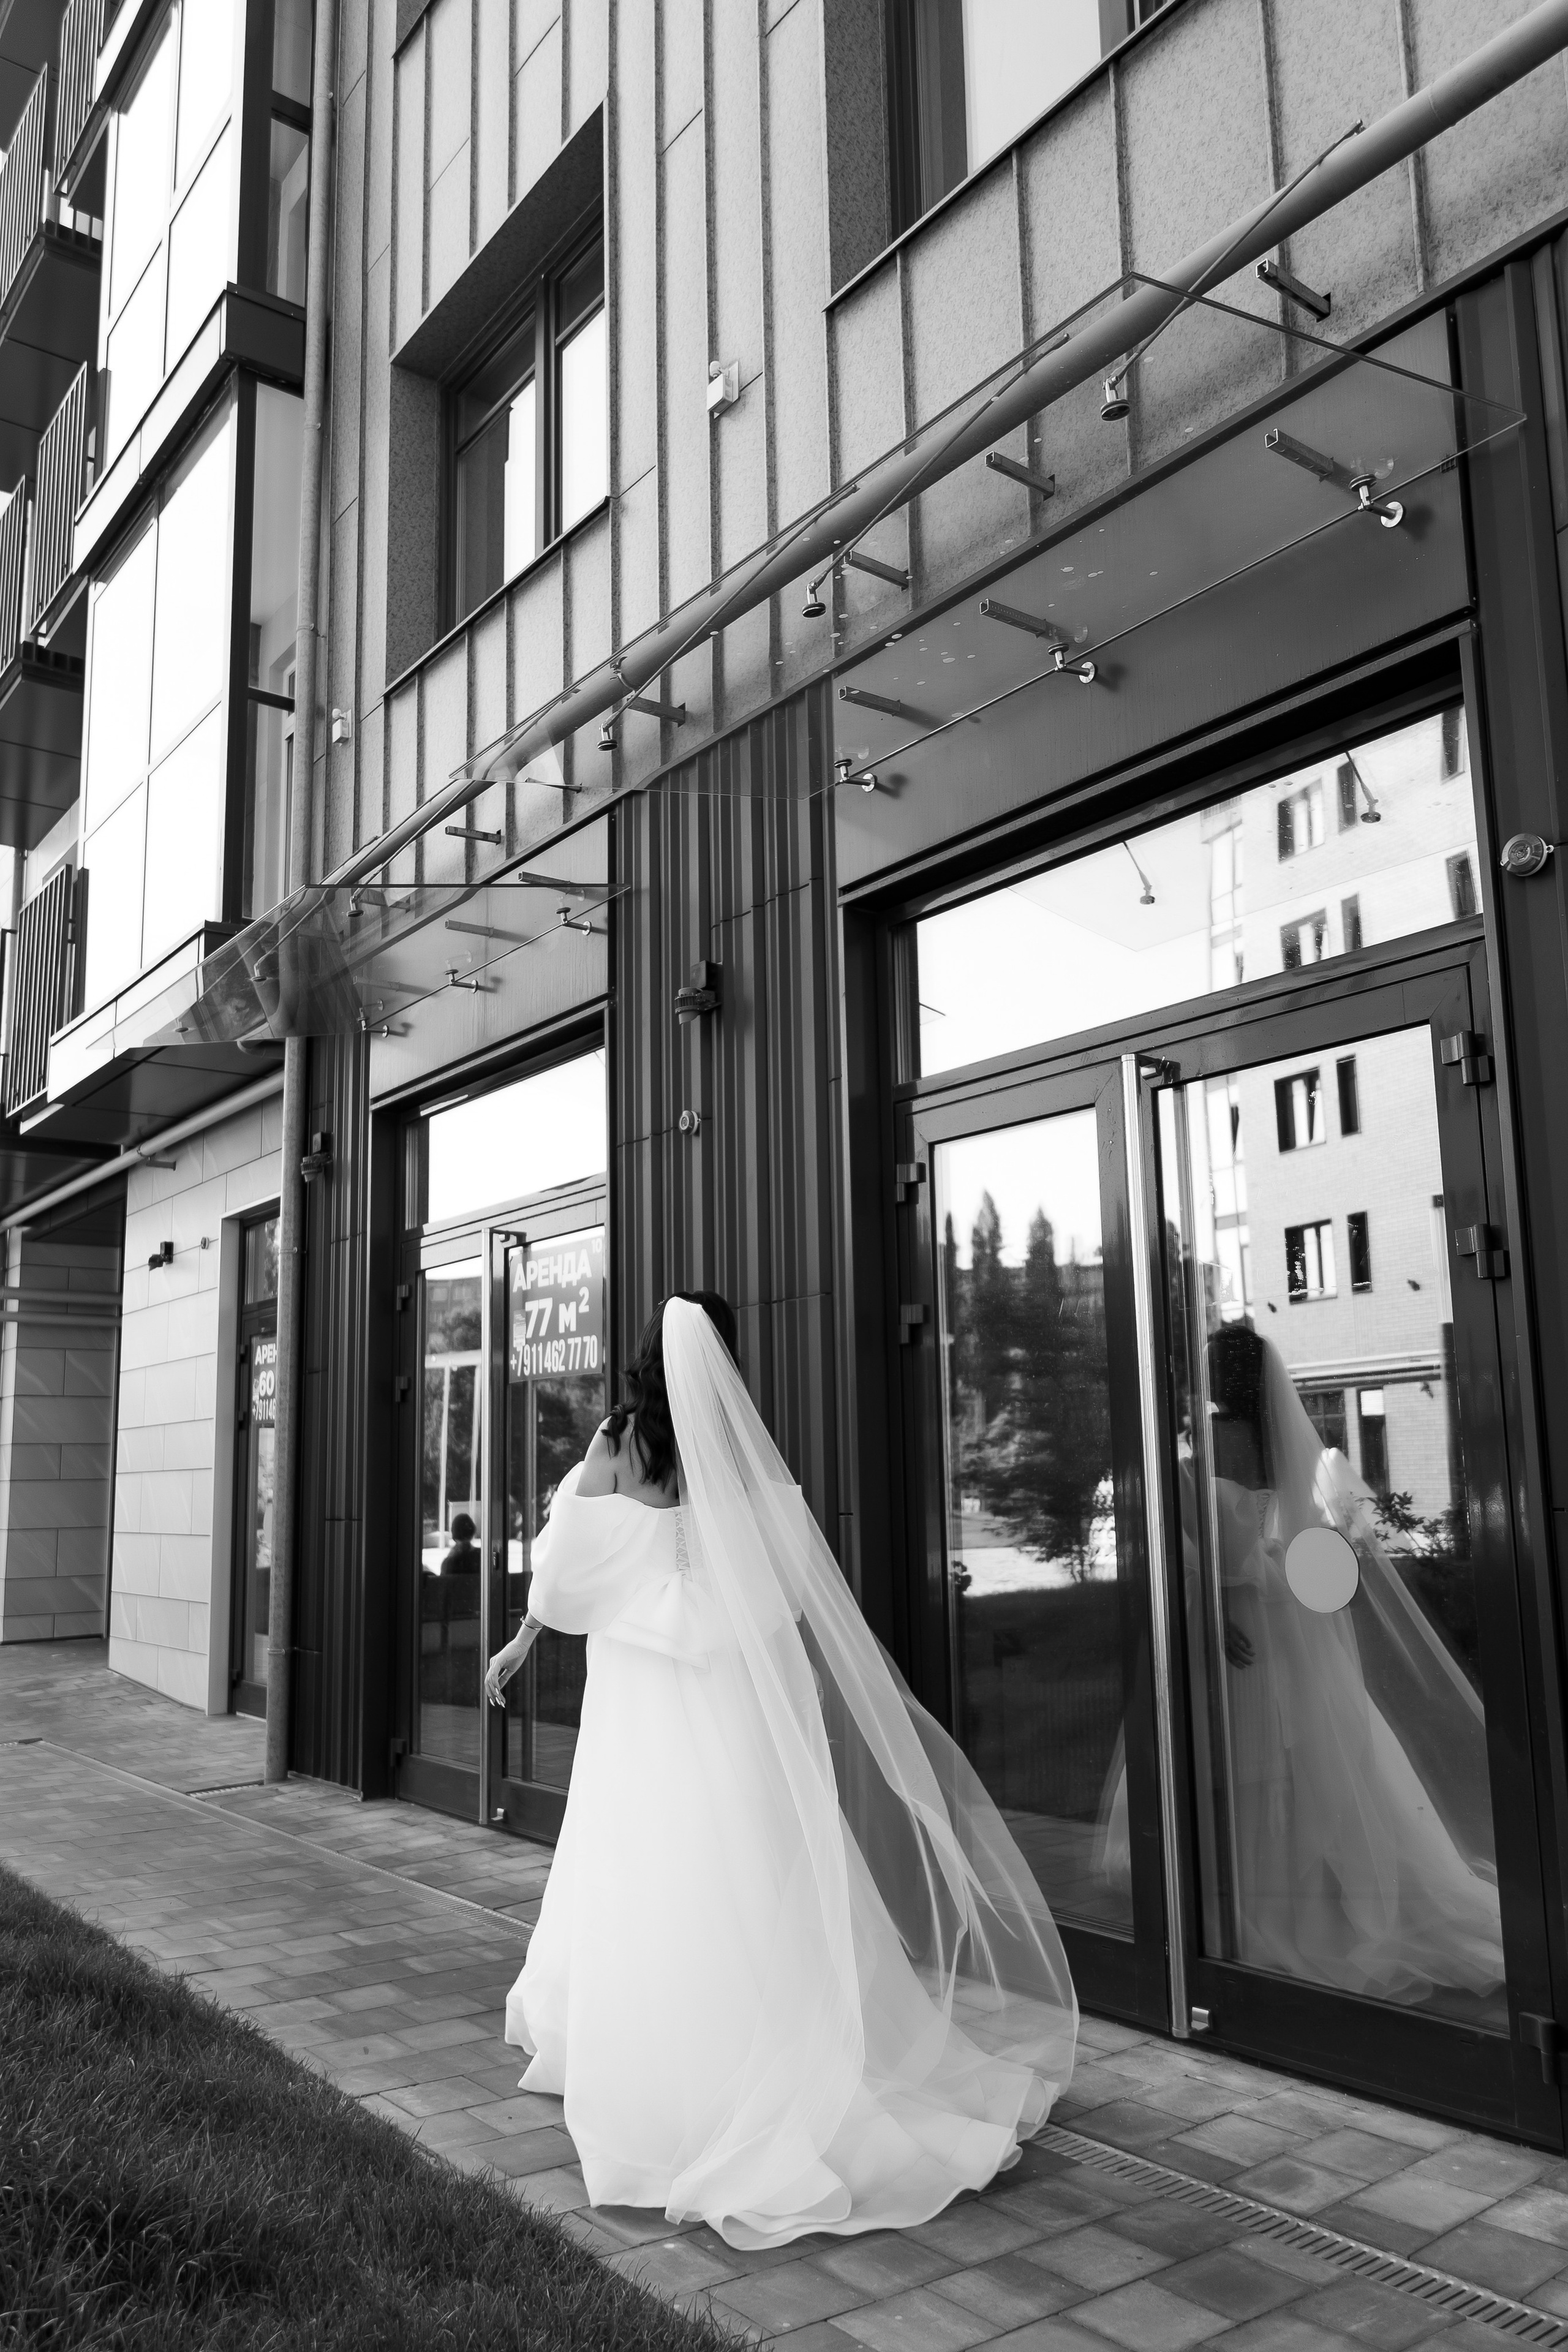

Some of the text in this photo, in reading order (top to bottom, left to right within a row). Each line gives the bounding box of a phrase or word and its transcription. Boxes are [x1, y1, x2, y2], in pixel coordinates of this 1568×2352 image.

[591, 1238, 602, 1254] 10
[513, 1248, 592, 1292] АРЕНДА
[525, 1297, 553, 1339] 77
[259, 1370, 275, 1396] 60
